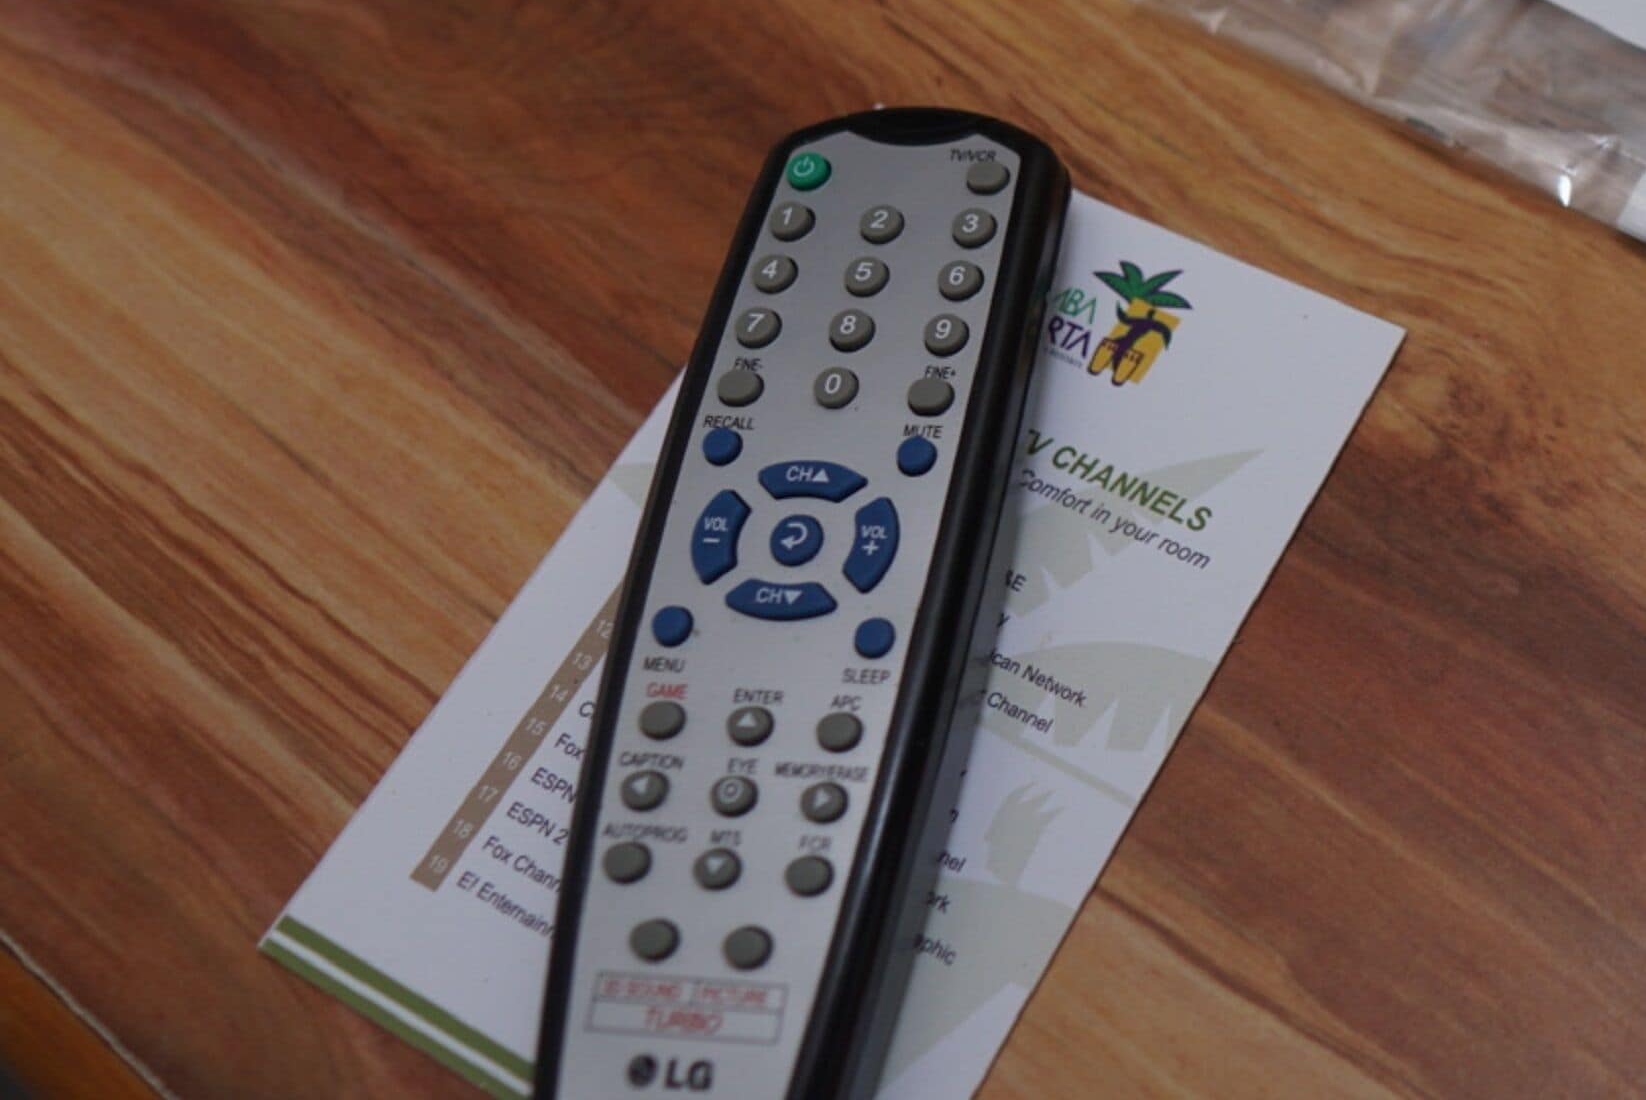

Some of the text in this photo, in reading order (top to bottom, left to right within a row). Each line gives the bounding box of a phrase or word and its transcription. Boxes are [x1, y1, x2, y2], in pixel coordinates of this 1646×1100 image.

[782, 207, 793, 226] 1
[869, 209, 889, 229] 2
[961, 213, 979, 233] 3
[761, 259, 778, 279] 4
[854, 262, 873, 281] 5
[948, 265, 966, 286] 6
[746, 312, 764, 333] 7
[839, 315, 857, 335] 8
[934, 318, 952, 340] 9
[823, 373, 842, 395] 0
[702, 414, 755, 431] RECALL
[903, 424, 944, 439] MUTE
[785, 465, 812, 483] CH
[1052, 445, 1213, 532] CHANNELS
[703, 516, 729, 532] VOL
[861, 524, 889, 540] VOL
[1090, 498, 1112, 524] in
[1110, 517, 1159, 548] your
[1159, 538, 1211, 570] room
[755, 587, 784, 605] CH
[643, 657, 685, 673] MENU
[841, 668, 891, 685] SLEEP
[1021, 664, 1087, 708] Network
[646, 682, 688, 699] GAME
[733, 688, 784, 704] ENTER
[830, 695, 862, 711] APC
[987, 691, 1054, 733] Channel
[554, 732, 583, 761] Fox
[619, 751, 684, 770] CAPTION
[727, 758, 758, 774] EYE
[530, 766, 577, 804] ESPN
[506, 801, 556, 838] ESPN
[553, 828, 569, 846] 2
[481, 835, 513, 865] Fox
[663, 1057, 715, 1092] LG
